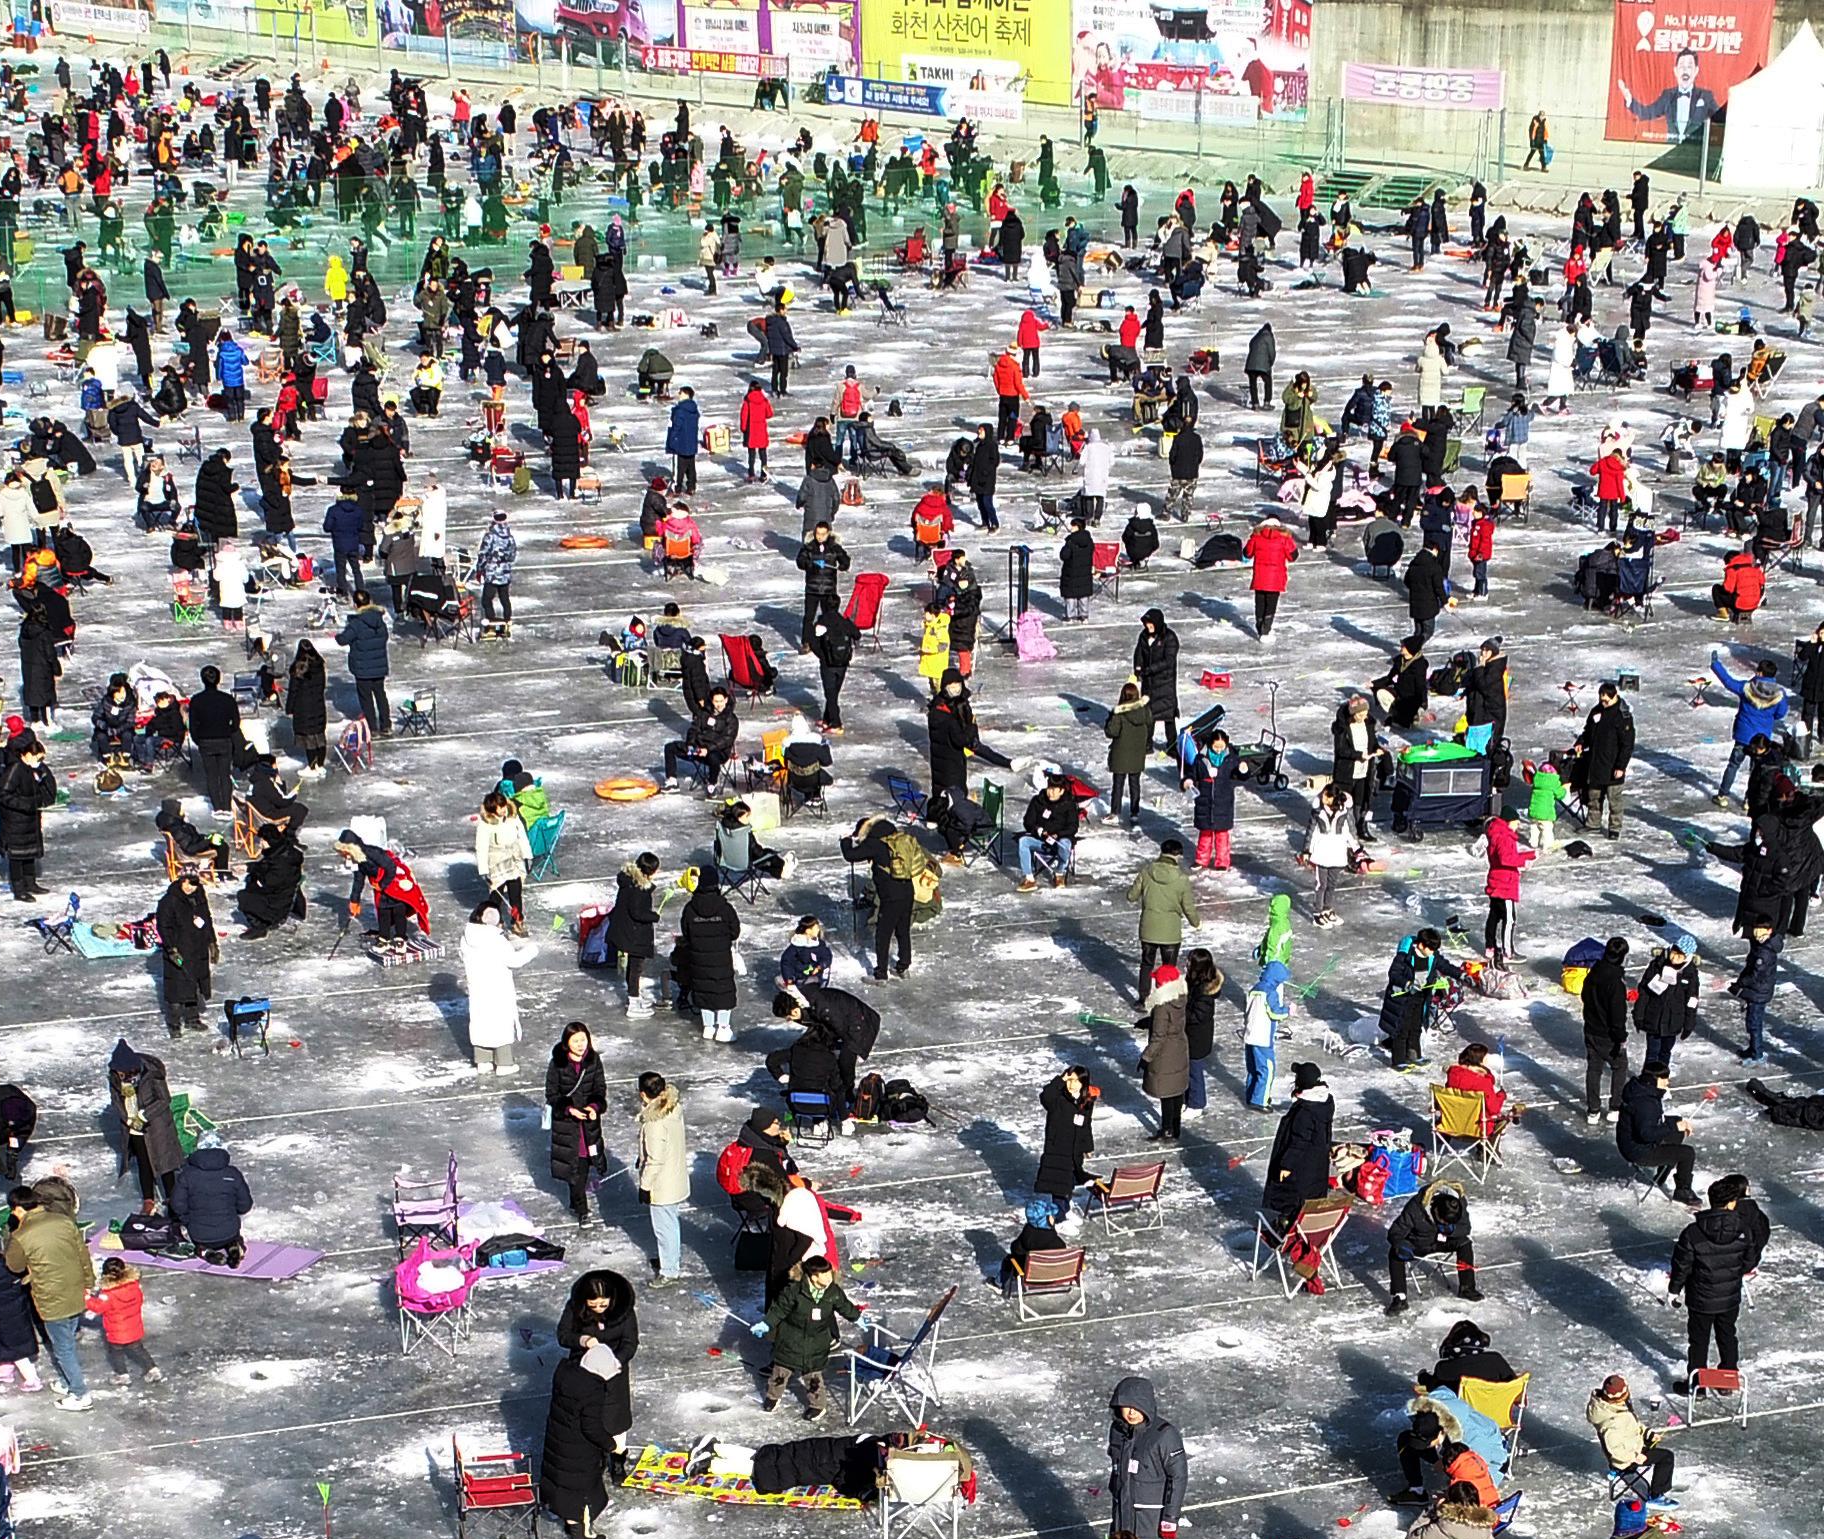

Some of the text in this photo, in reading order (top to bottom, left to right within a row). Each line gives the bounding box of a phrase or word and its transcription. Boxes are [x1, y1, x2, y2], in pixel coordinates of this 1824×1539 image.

[891, 11, 1031, 47] 화천 산천어 축제
[1664, 14, 1686, 27] No.1
[1654, 29, 1743, 54] 물반고기반
[919, 66, 954, 81] TAKHI
